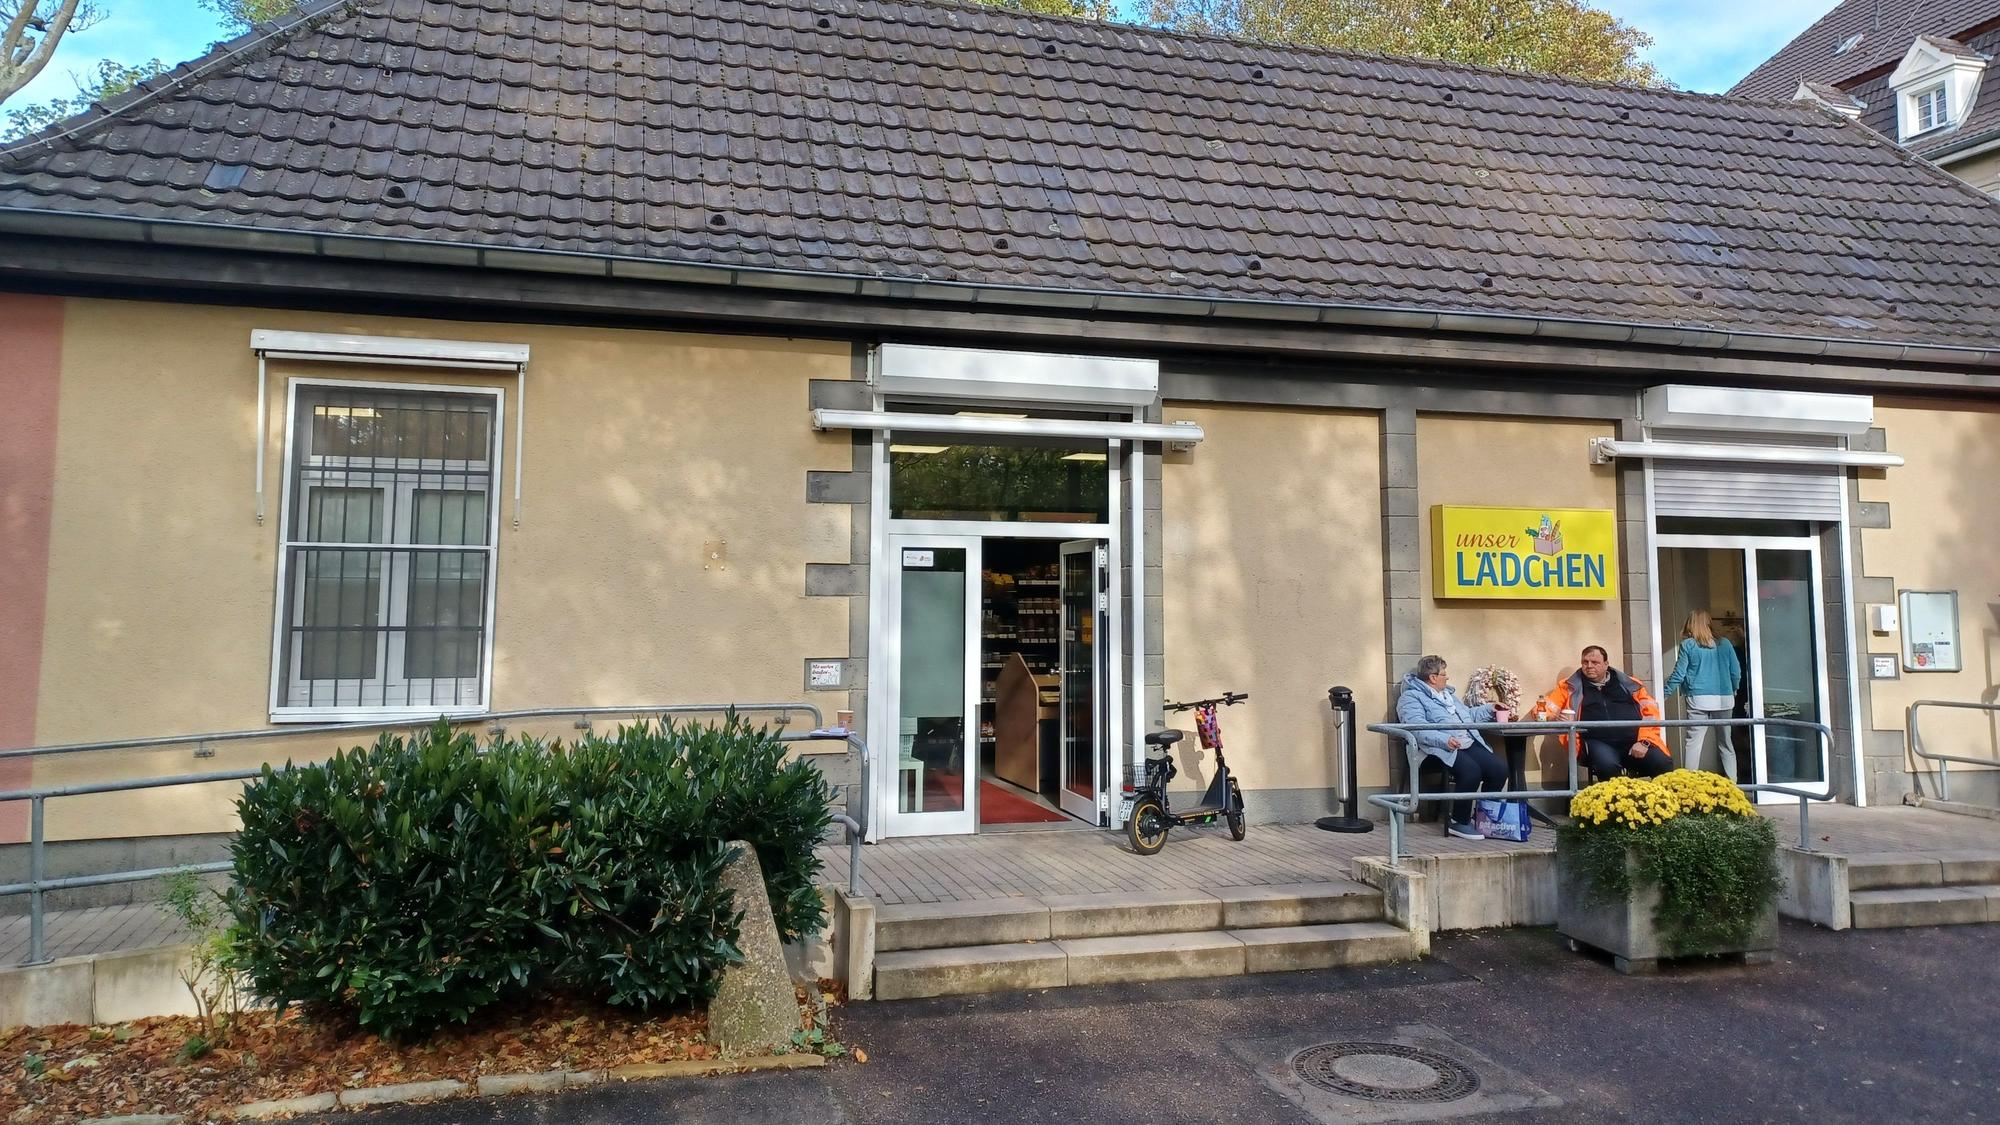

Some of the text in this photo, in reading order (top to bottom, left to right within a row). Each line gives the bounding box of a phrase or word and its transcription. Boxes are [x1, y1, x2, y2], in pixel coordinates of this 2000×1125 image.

[1456, 533, 1520, 549] unser
[1456, 551, 1605, 588] LÄDCHEN
[1491, 822, 1517, 831] active
